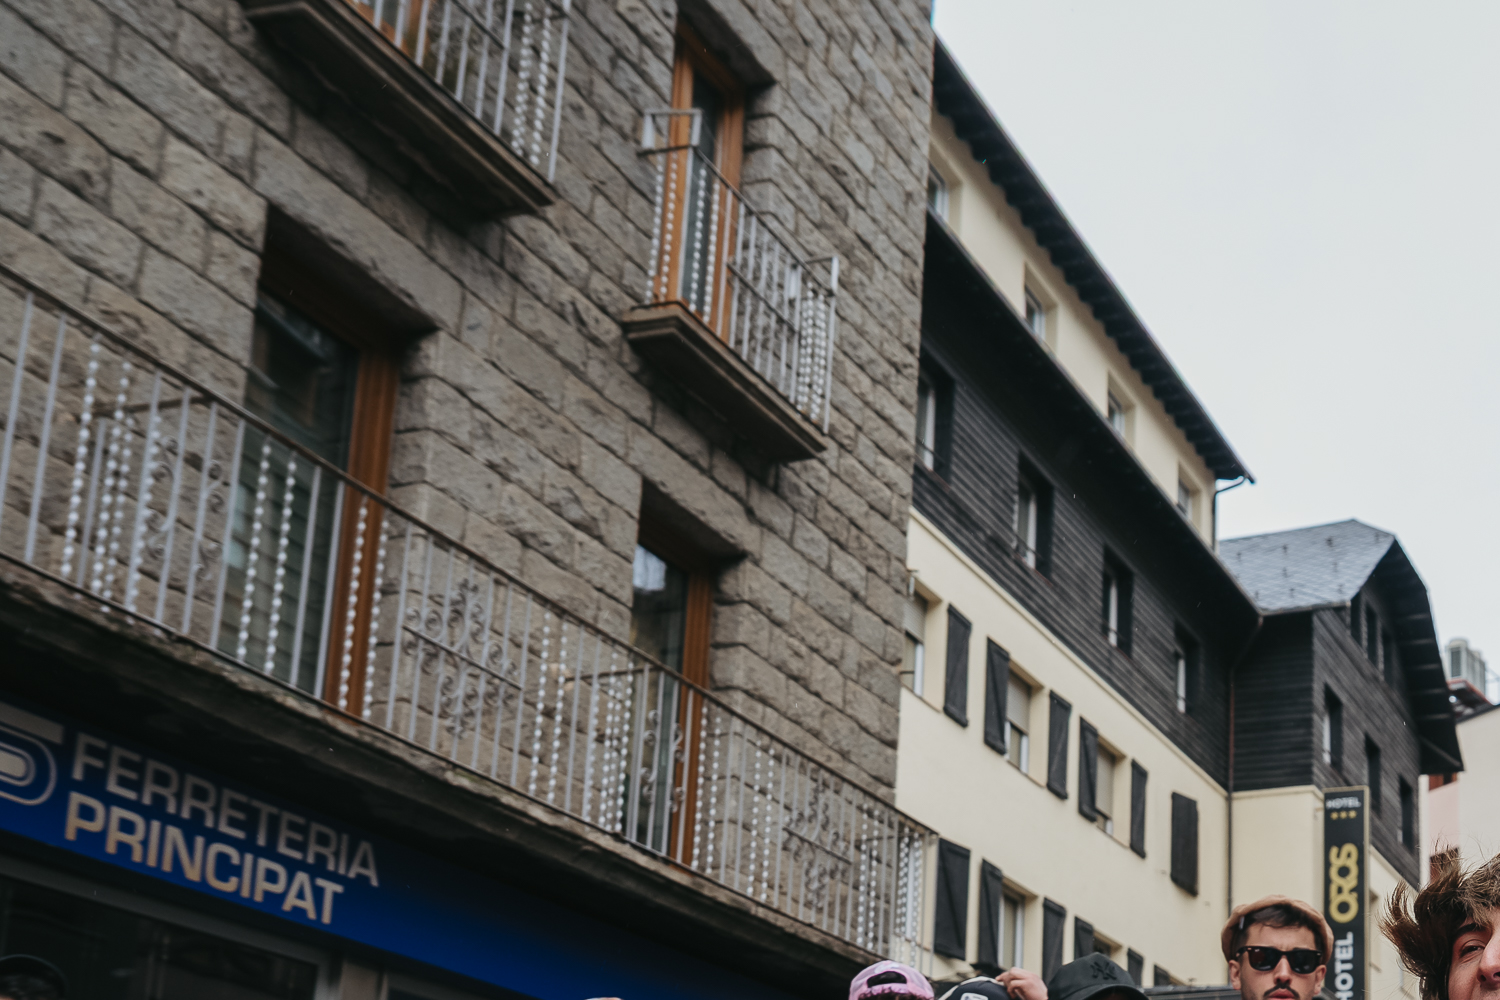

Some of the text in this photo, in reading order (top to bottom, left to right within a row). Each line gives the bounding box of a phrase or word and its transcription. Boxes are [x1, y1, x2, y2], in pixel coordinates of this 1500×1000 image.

[72, 732, 379, 887] FERRETERIA
[1326, 796, 1361, 810] HOTEL
[65, 791, 344, 925] PRINCIPAT
[1329, 843, 1359, 923] OROS
